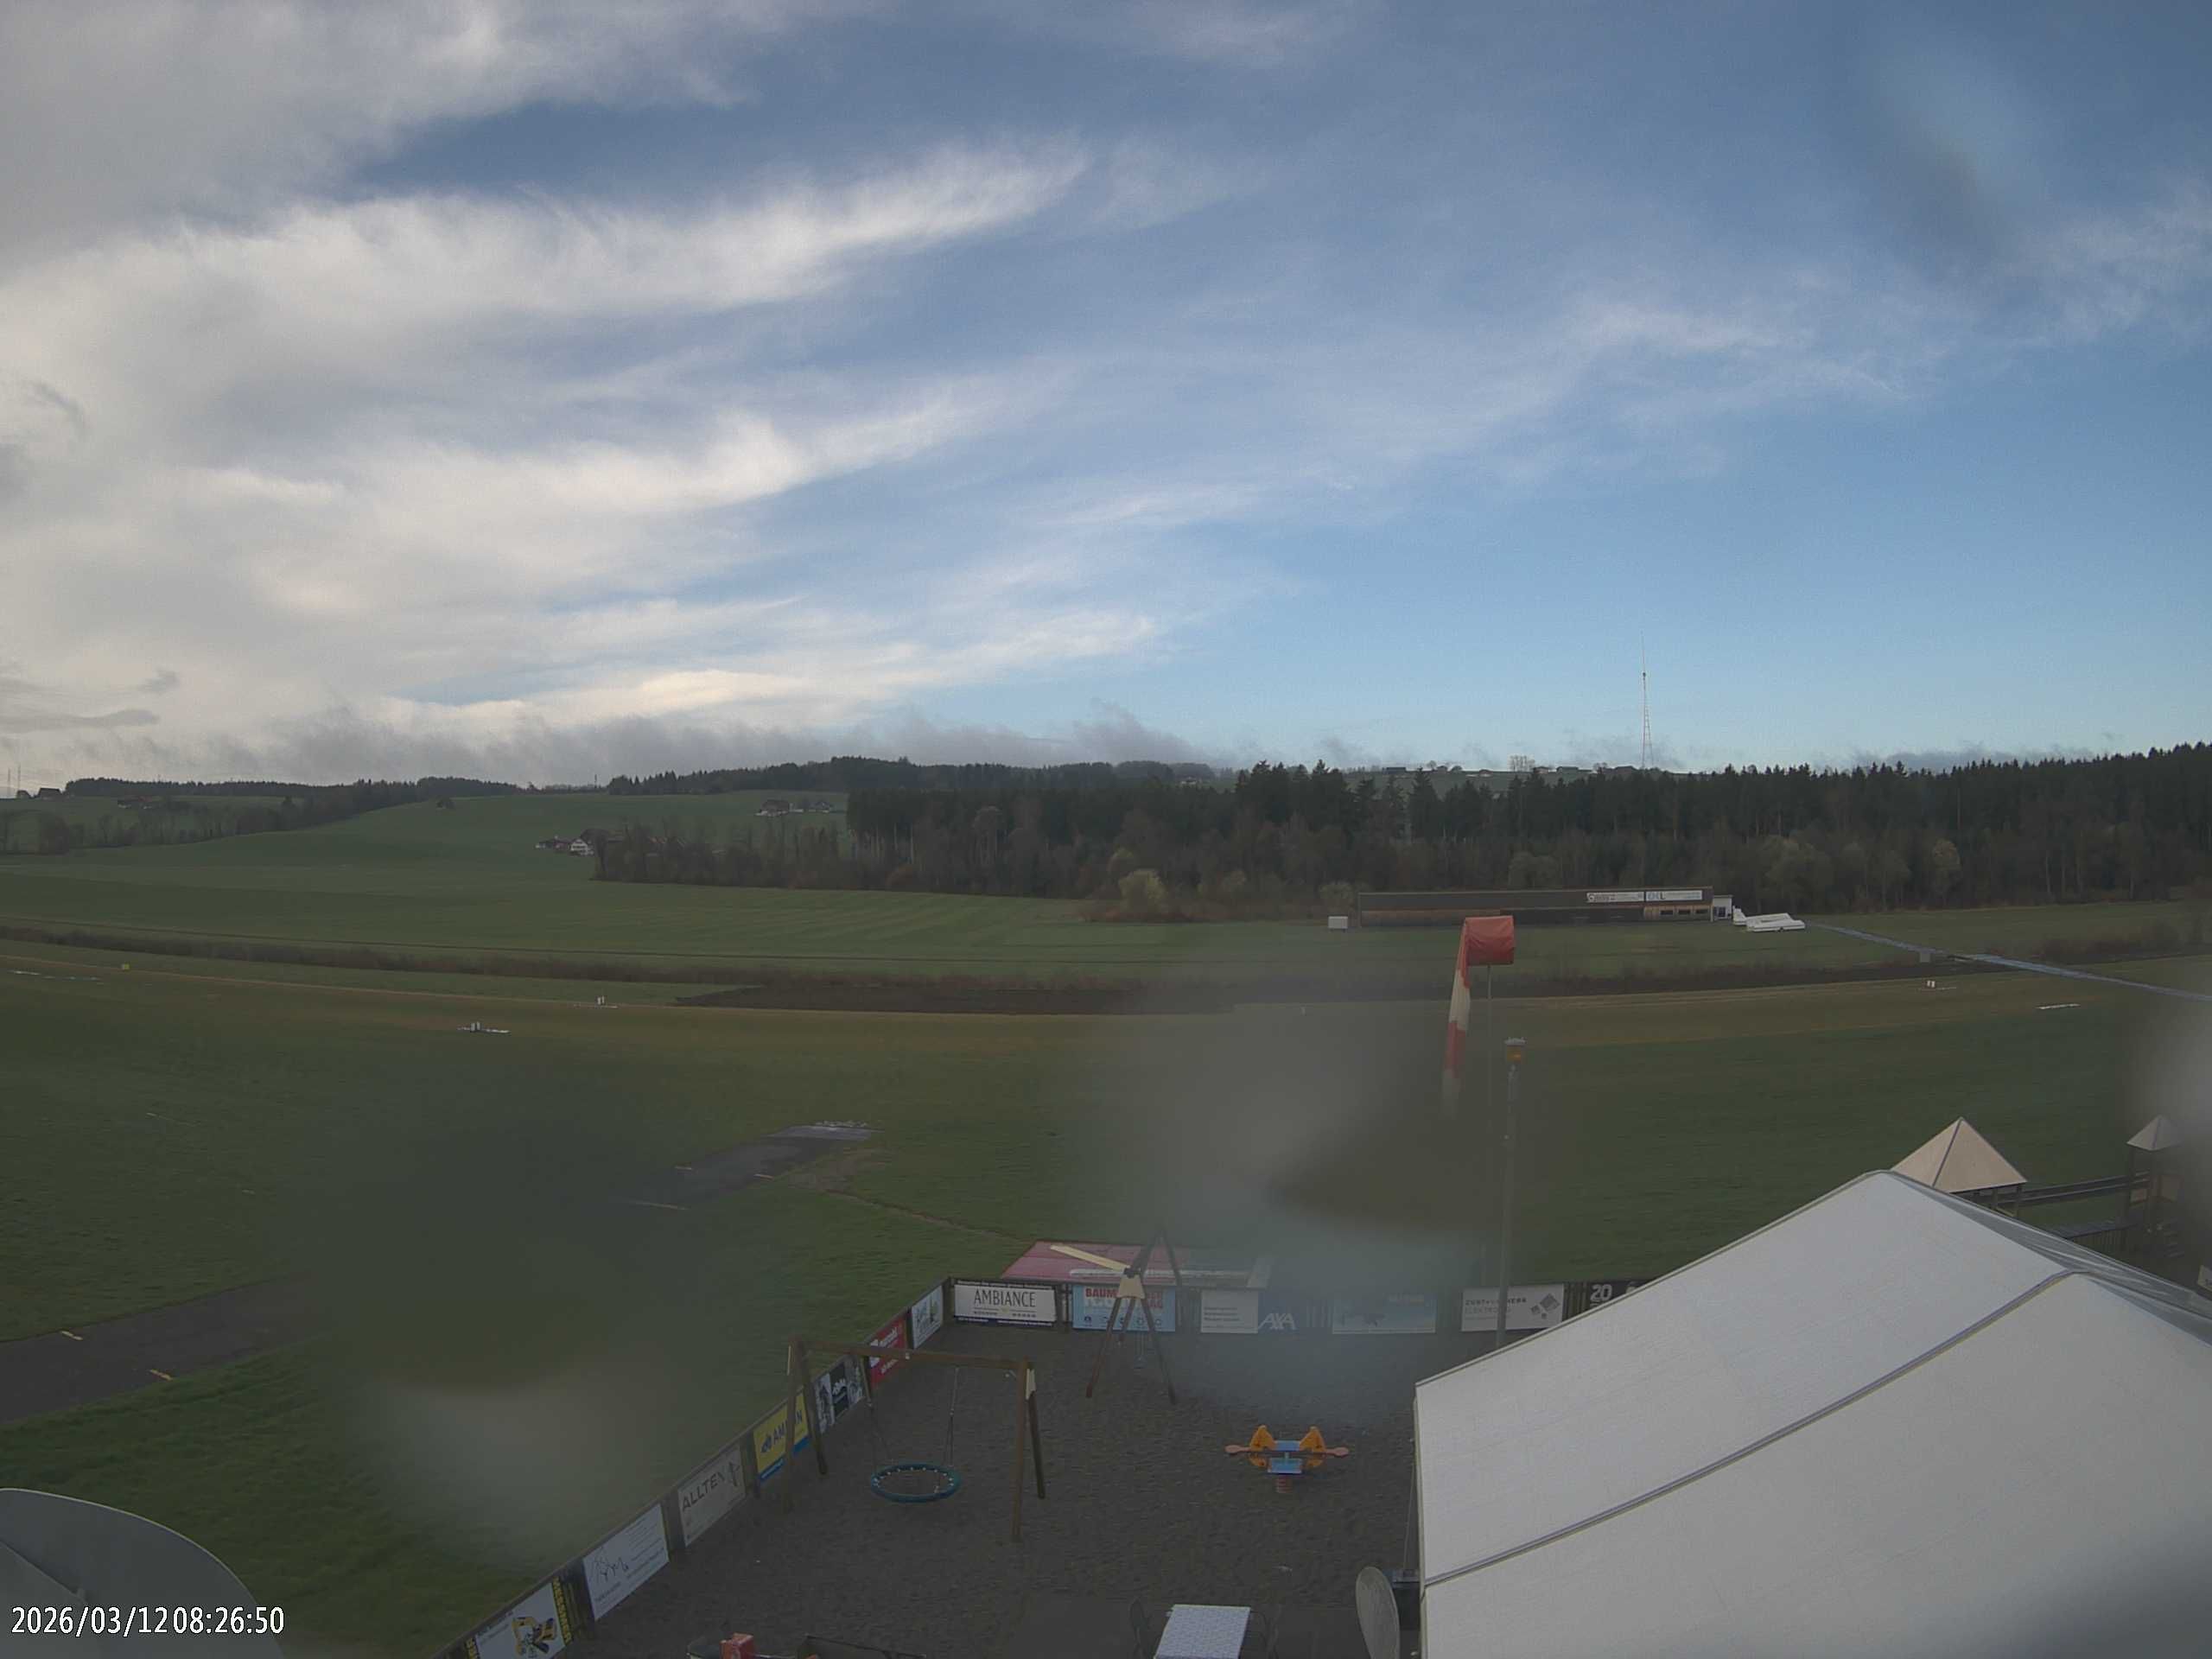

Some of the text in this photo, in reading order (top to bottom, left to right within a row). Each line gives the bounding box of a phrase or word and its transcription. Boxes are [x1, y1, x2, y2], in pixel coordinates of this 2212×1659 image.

[974, 1289, 1036, 1307] AMBIANCE
[1590, 1284, 1612, 1302] 20
[1258, 1313, 1296, 1331] AXA
